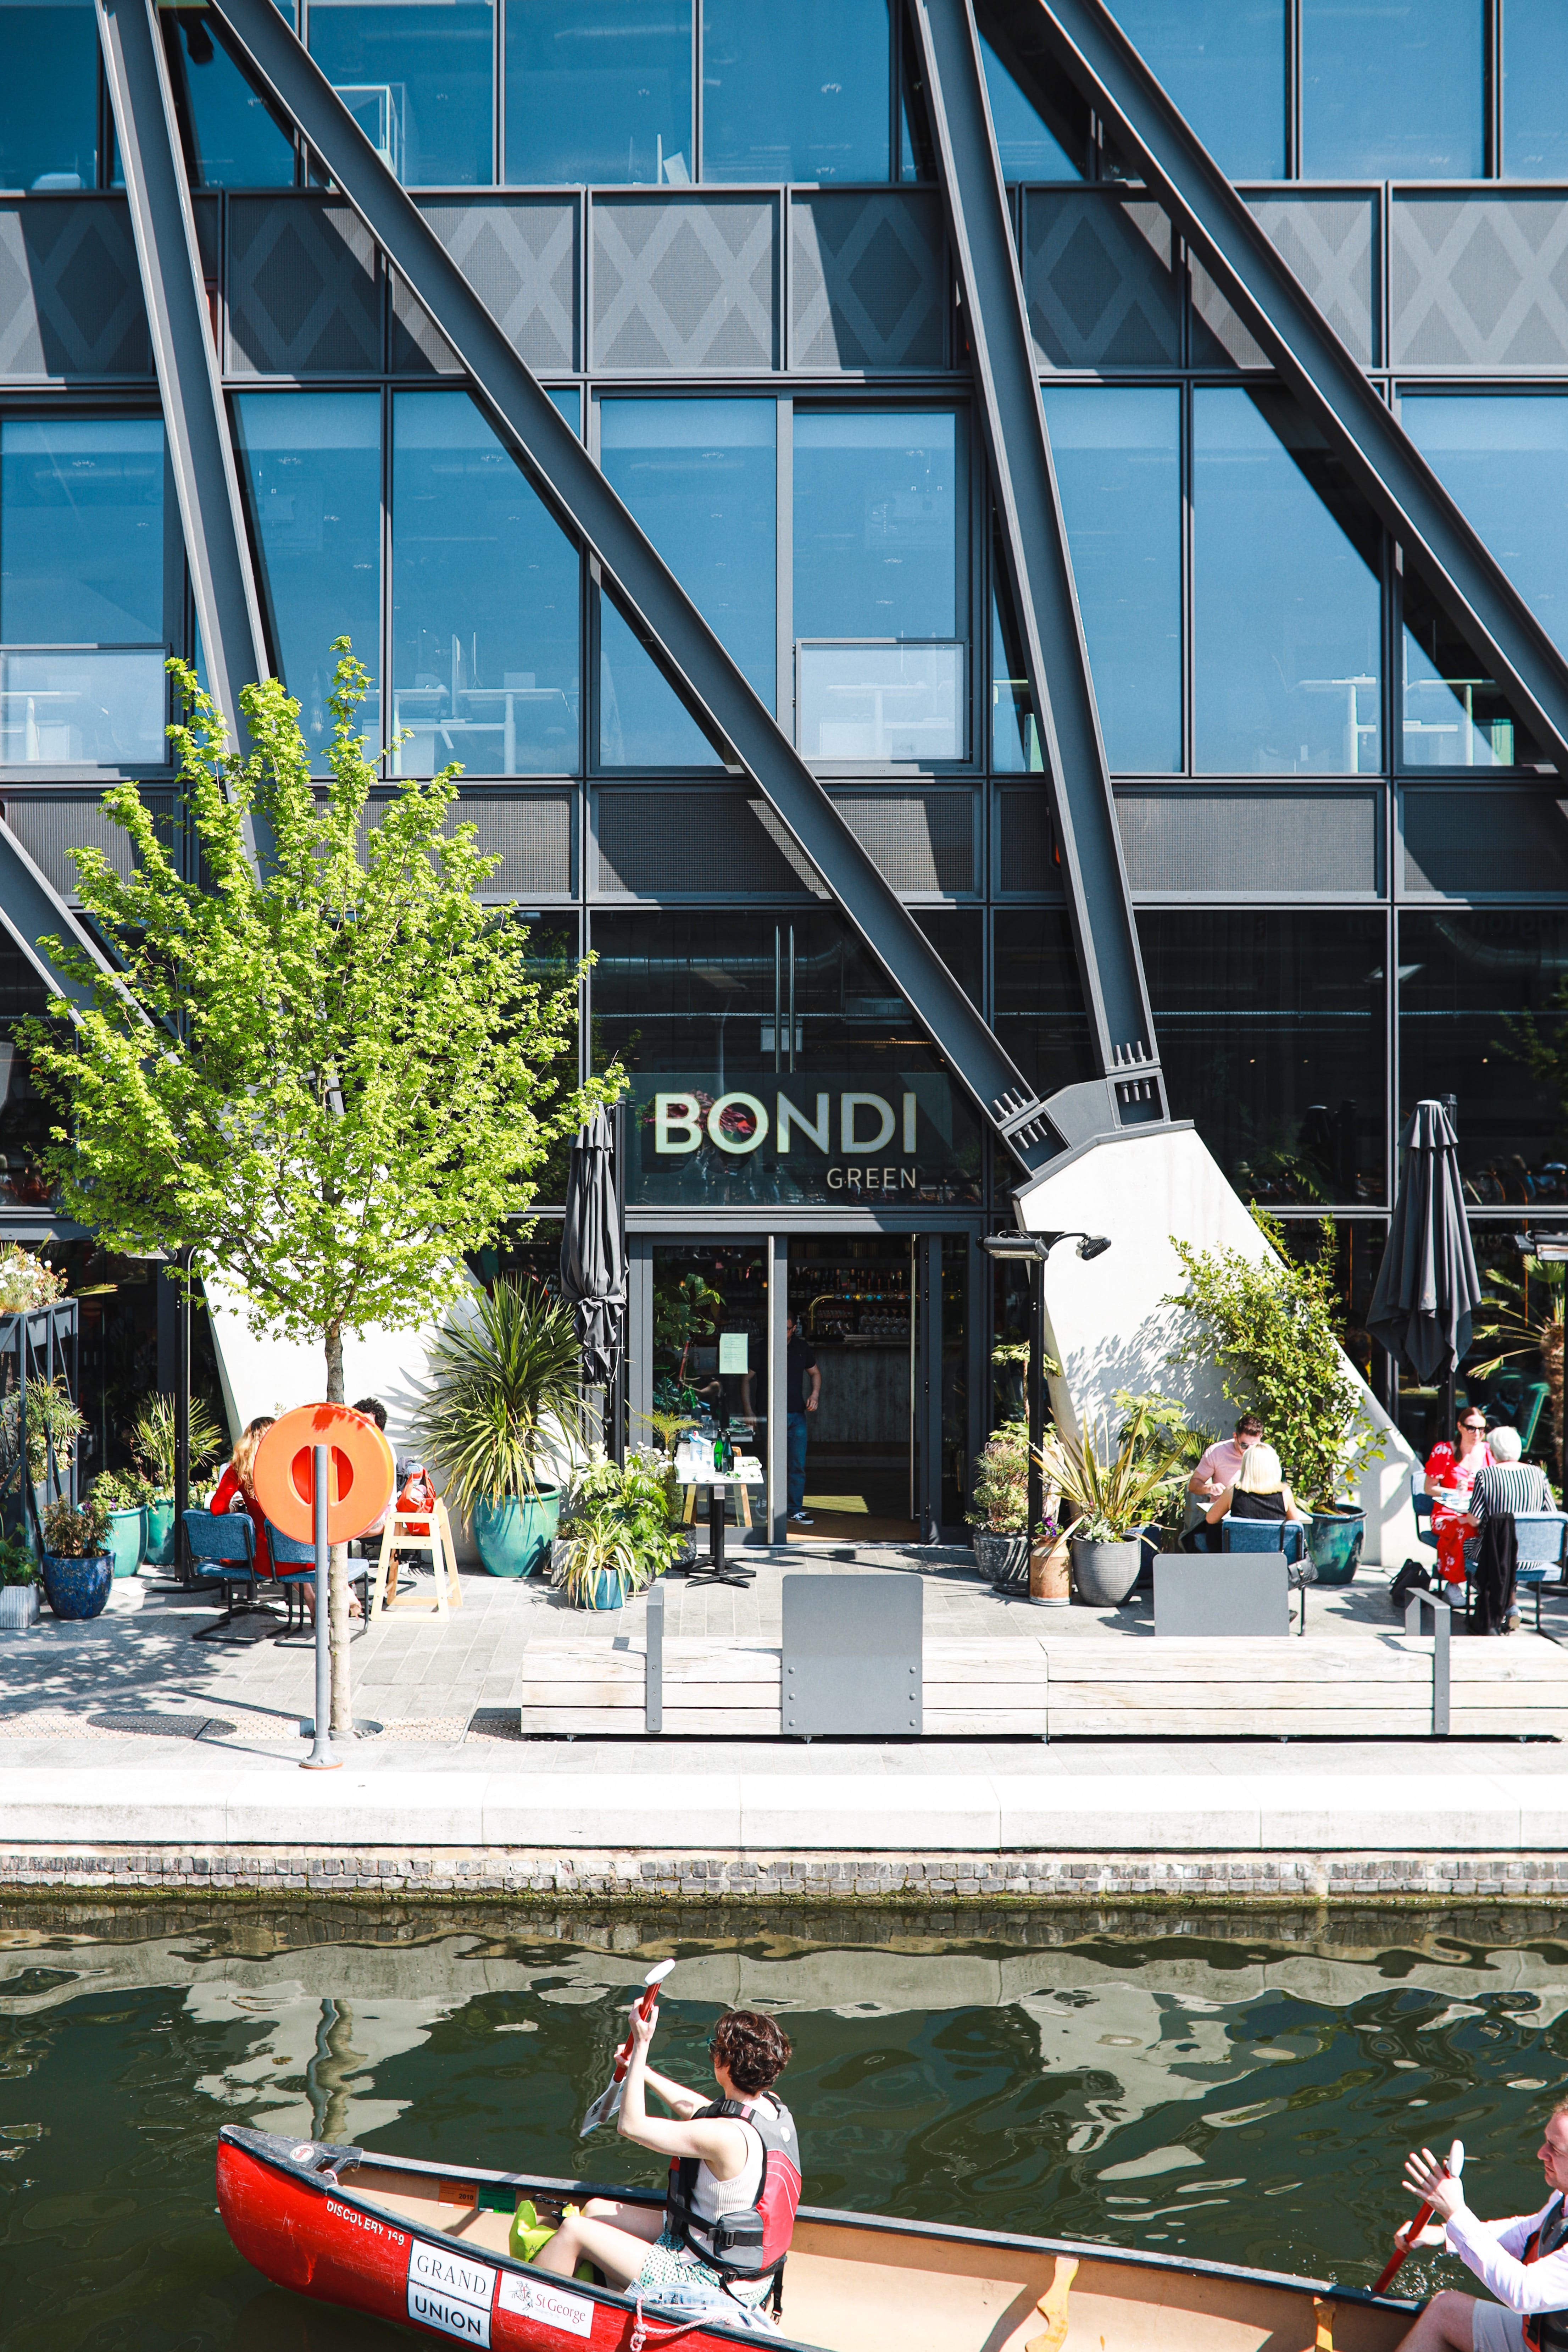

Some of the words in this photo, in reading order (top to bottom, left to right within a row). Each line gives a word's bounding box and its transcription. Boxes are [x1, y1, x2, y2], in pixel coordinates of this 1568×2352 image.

[655, 1091, 916, 1155] BONDI
[827, 1168, 916, 1189] GREEN
[417, 2255, 486, 2294] GRAND
[415, 2295, 480, 2336] UNION
[535, 2294, 545, 2308] St
[547, 2298, 585, 2324] George
